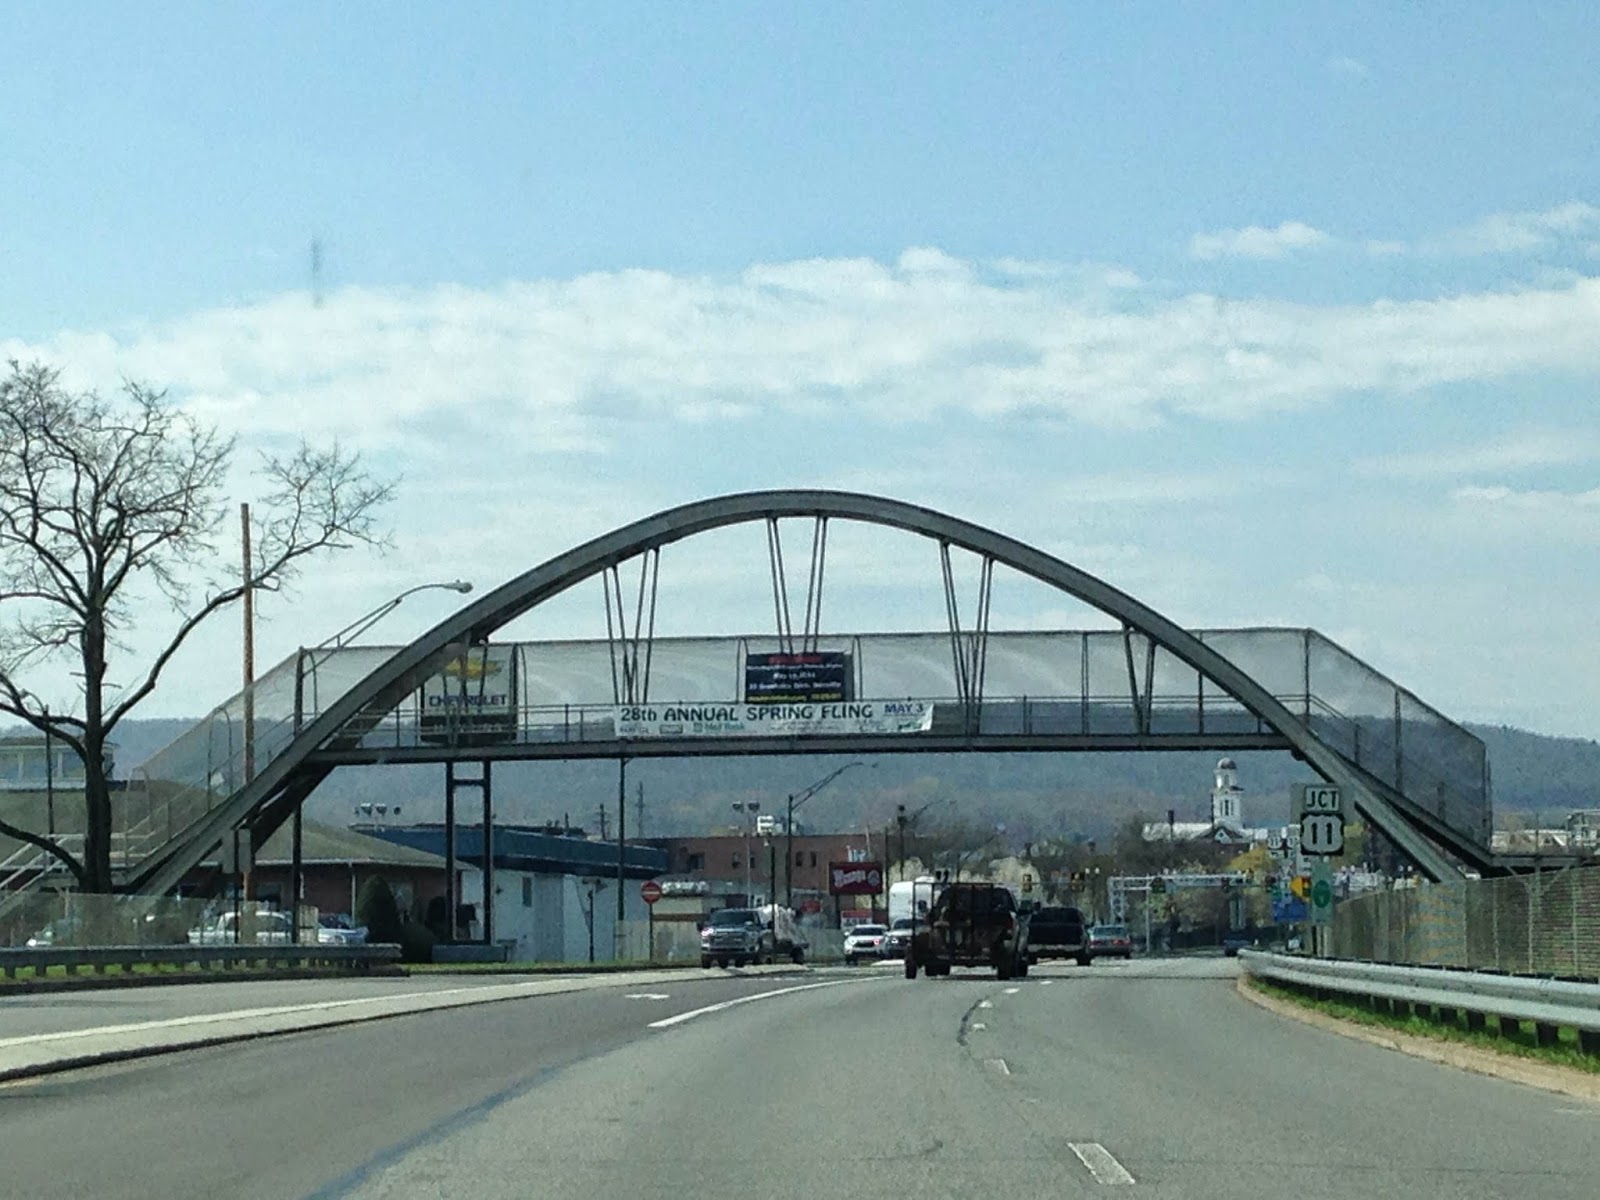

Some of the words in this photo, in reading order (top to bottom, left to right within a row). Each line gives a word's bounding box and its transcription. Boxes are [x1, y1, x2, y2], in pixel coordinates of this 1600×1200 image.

[620, 706, 658, 722] 28th
[663, 706, 739, 722] ANNUAL
[745, 705, 814, 721] SPRING
[820, 703, 874, 719] FLING
[884, 703, 913, 714] MAY
[915, 703, 924, 713] 3
[1306, 790, 1337, 808] JCT
[1311, 822, 1333, 845] 11
